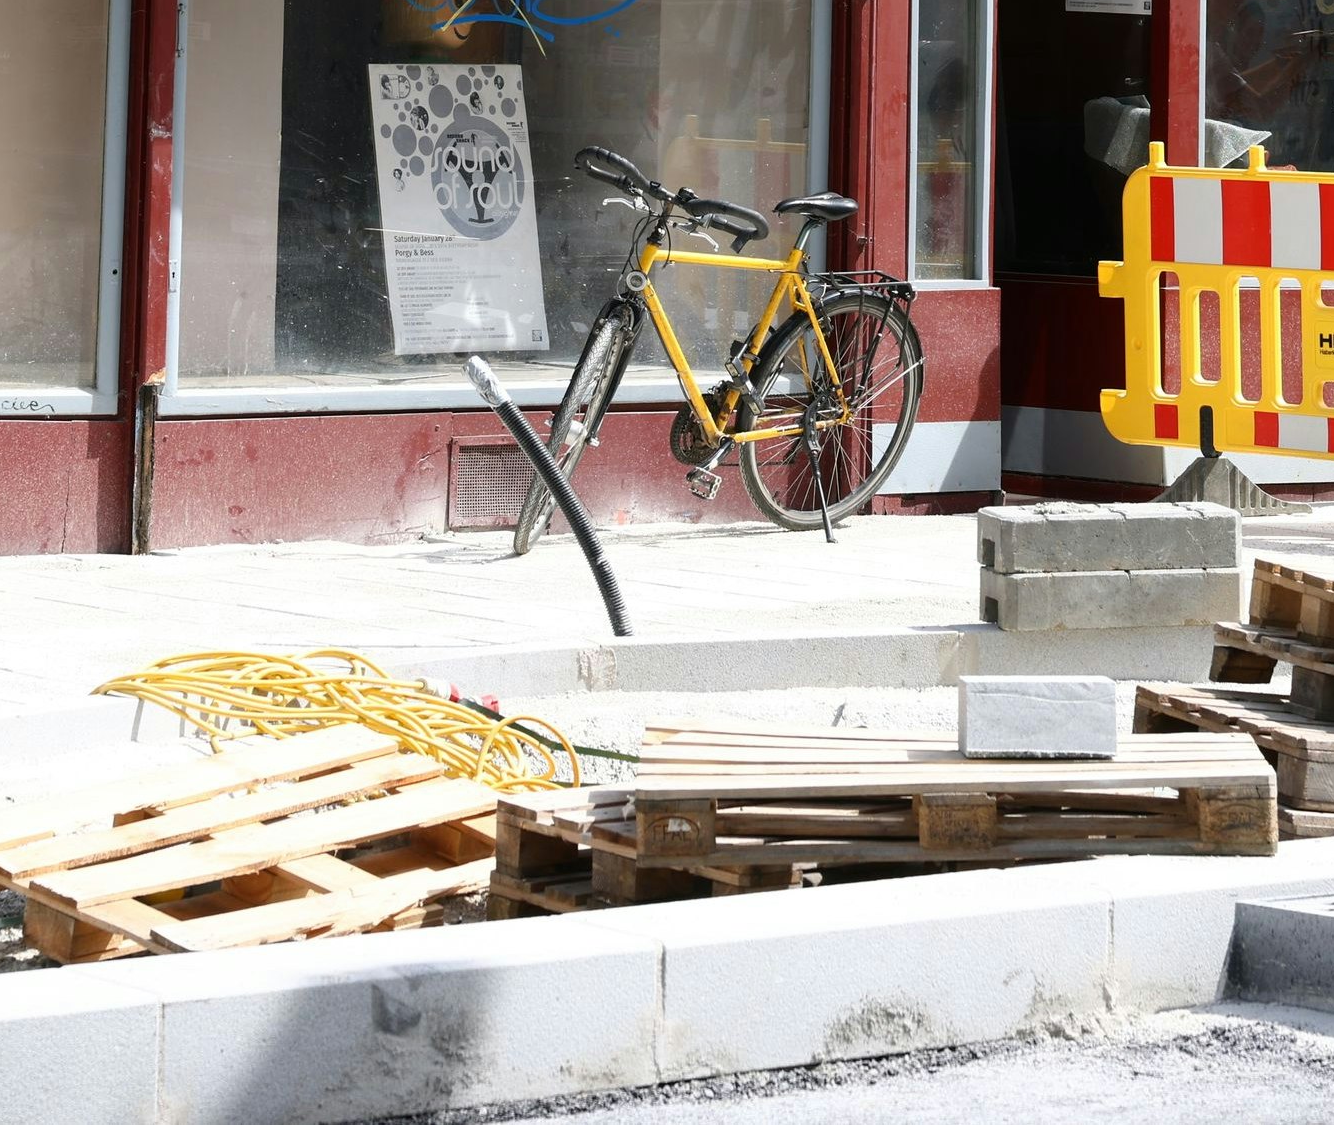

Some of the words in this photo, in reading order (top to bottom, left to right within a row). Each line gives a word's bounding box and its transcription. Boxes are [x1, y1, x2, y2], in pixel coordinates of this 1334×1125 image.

[431, 143, 516, 173] sound
[434, 172, 461, 210] of
[465, 171, 523, 210] soul
[394, 235, 420, 244] Saturday
[421, 235, 444, 244] January
[395, 249, 413, 258] Porgy
